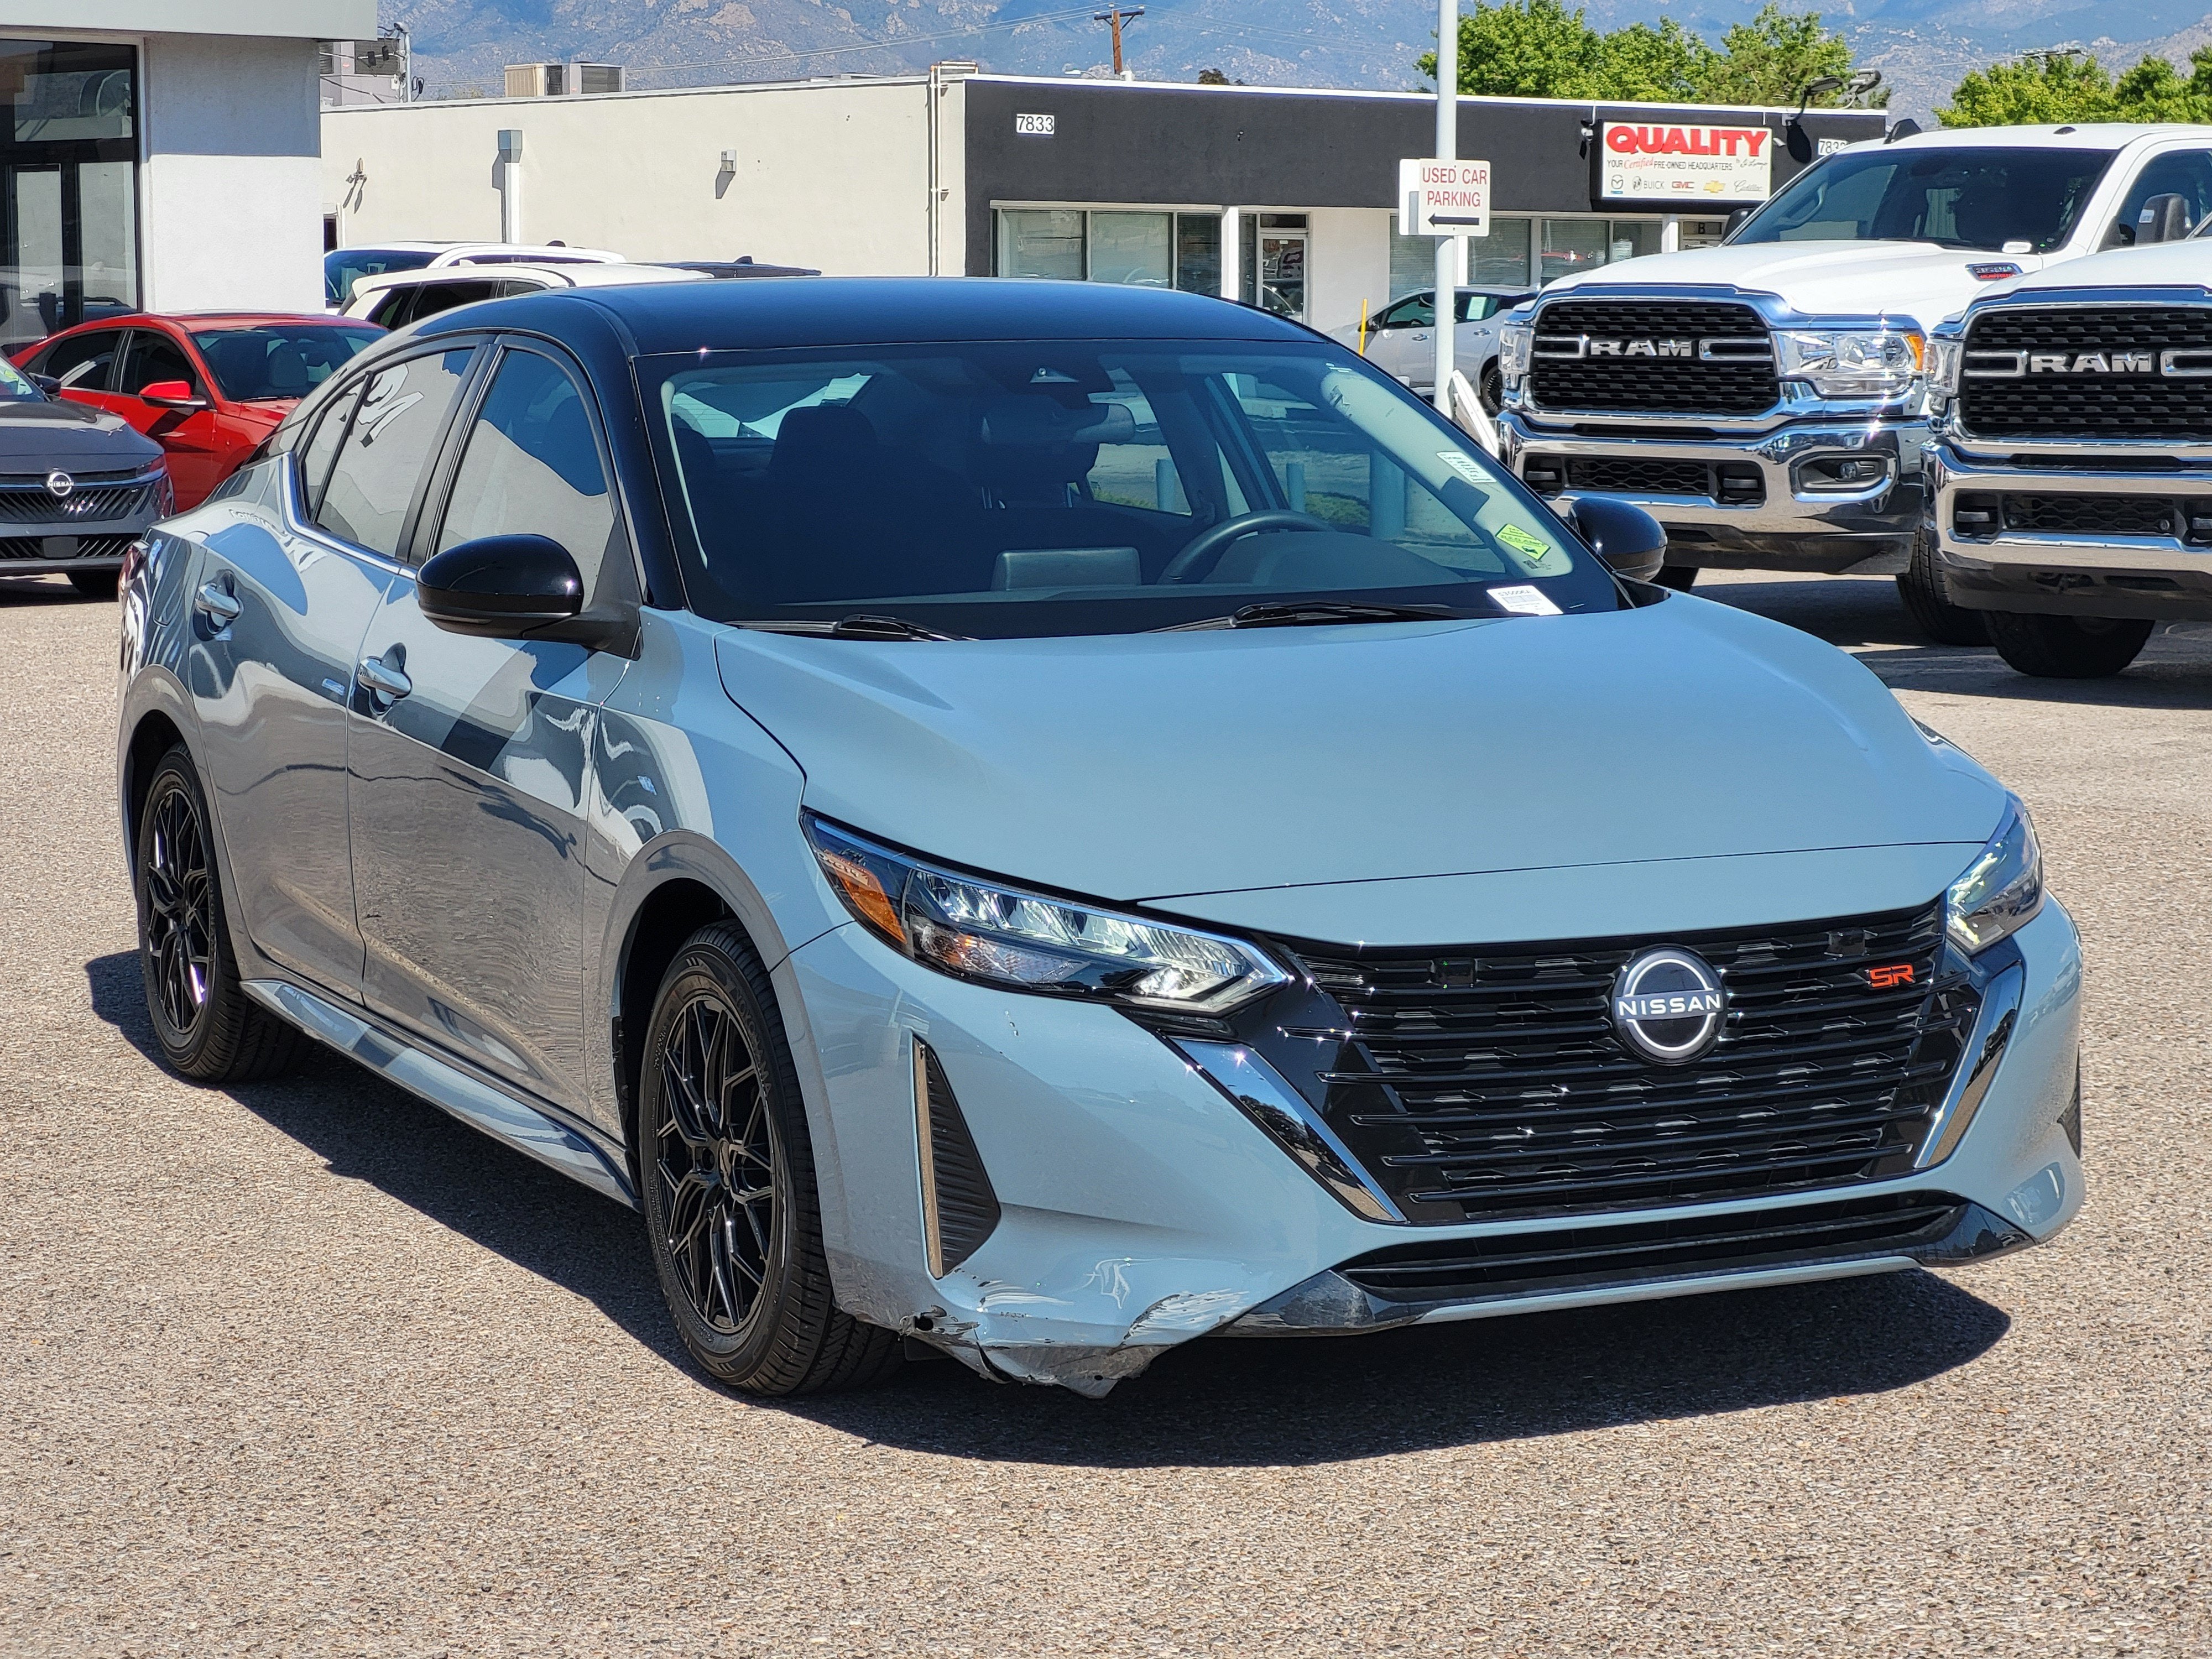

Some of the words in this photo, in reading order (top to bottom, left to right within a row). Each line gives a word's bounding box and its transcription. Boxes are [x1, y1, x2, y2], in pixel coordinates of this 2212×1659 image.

[1017, 116, 1054, 132] 7833
[1606, 126, 1768, 157] QUALITY
[1607, 159, 1624, 168] YOUR
[1624, 157, 1654, 170] Certified
[1653, 161, 1686, 170] PRE-OWNED
[1688, 161, 1733, 171] HEADQUARTERS
[1422, 167, 1457, 184] USED
[1462, 169, 1488, 185] CAR
[1643, 180, 1665, 190] BUICK
[1671, 181, 1695, 189] GMC
[1427, 190, 1481, 207] PARKING
[1590, 338, 1693, 357] RAM
[2030, 351, 2152, 373] RAM
[1869, 963, 1914, 989] SR
[1619, 993, 1722, 1018] NISSAN
